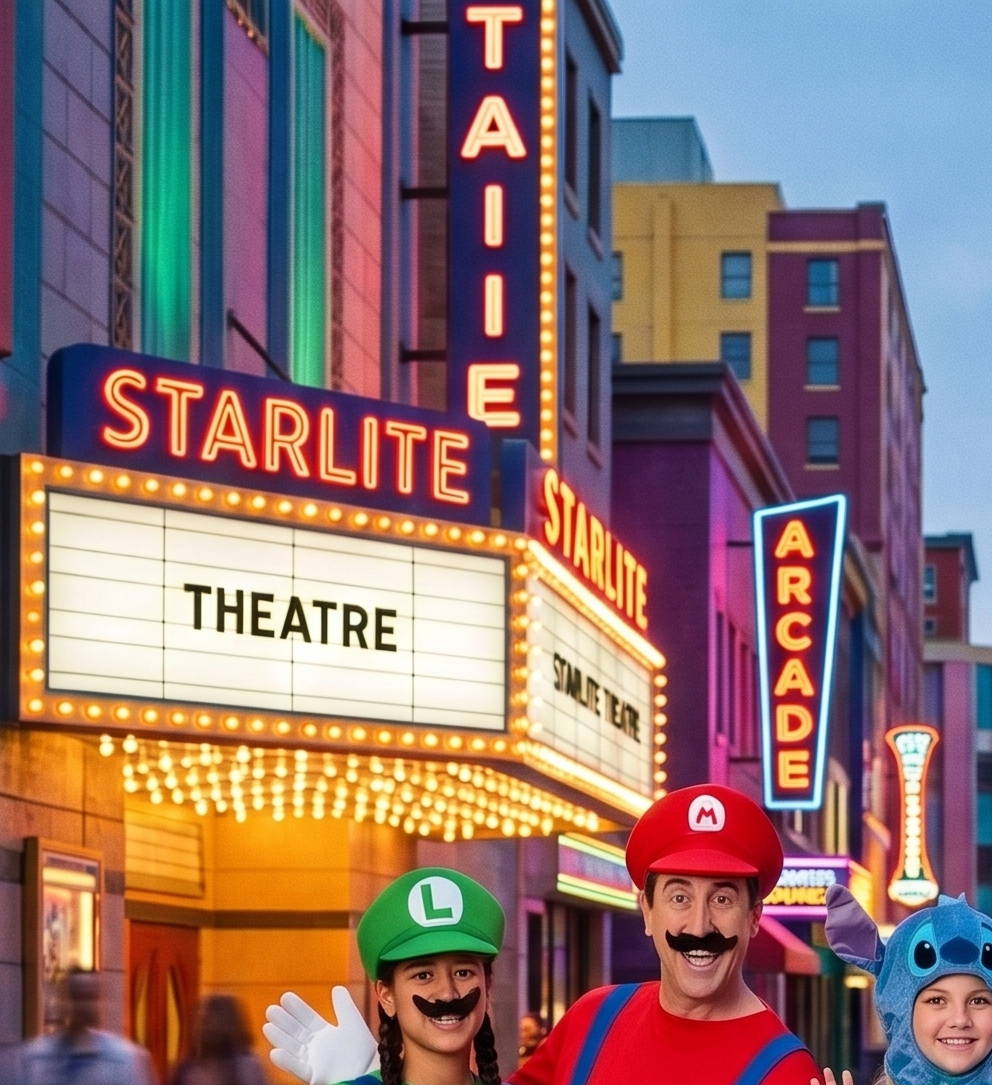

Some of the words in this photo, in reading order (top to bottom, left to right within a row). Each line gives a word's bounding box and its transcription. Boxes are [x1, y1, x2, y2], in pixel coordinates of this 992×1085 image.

[103, 369, 470, 504] STARLITE
[543, 468, 648, 631] STARLITE
[183, 582, 398, 653] THEATRE
[774, 519, 815, 789] ARCADE
[696, 806, 717, 825] M
[419, 883, 453, 921] L
